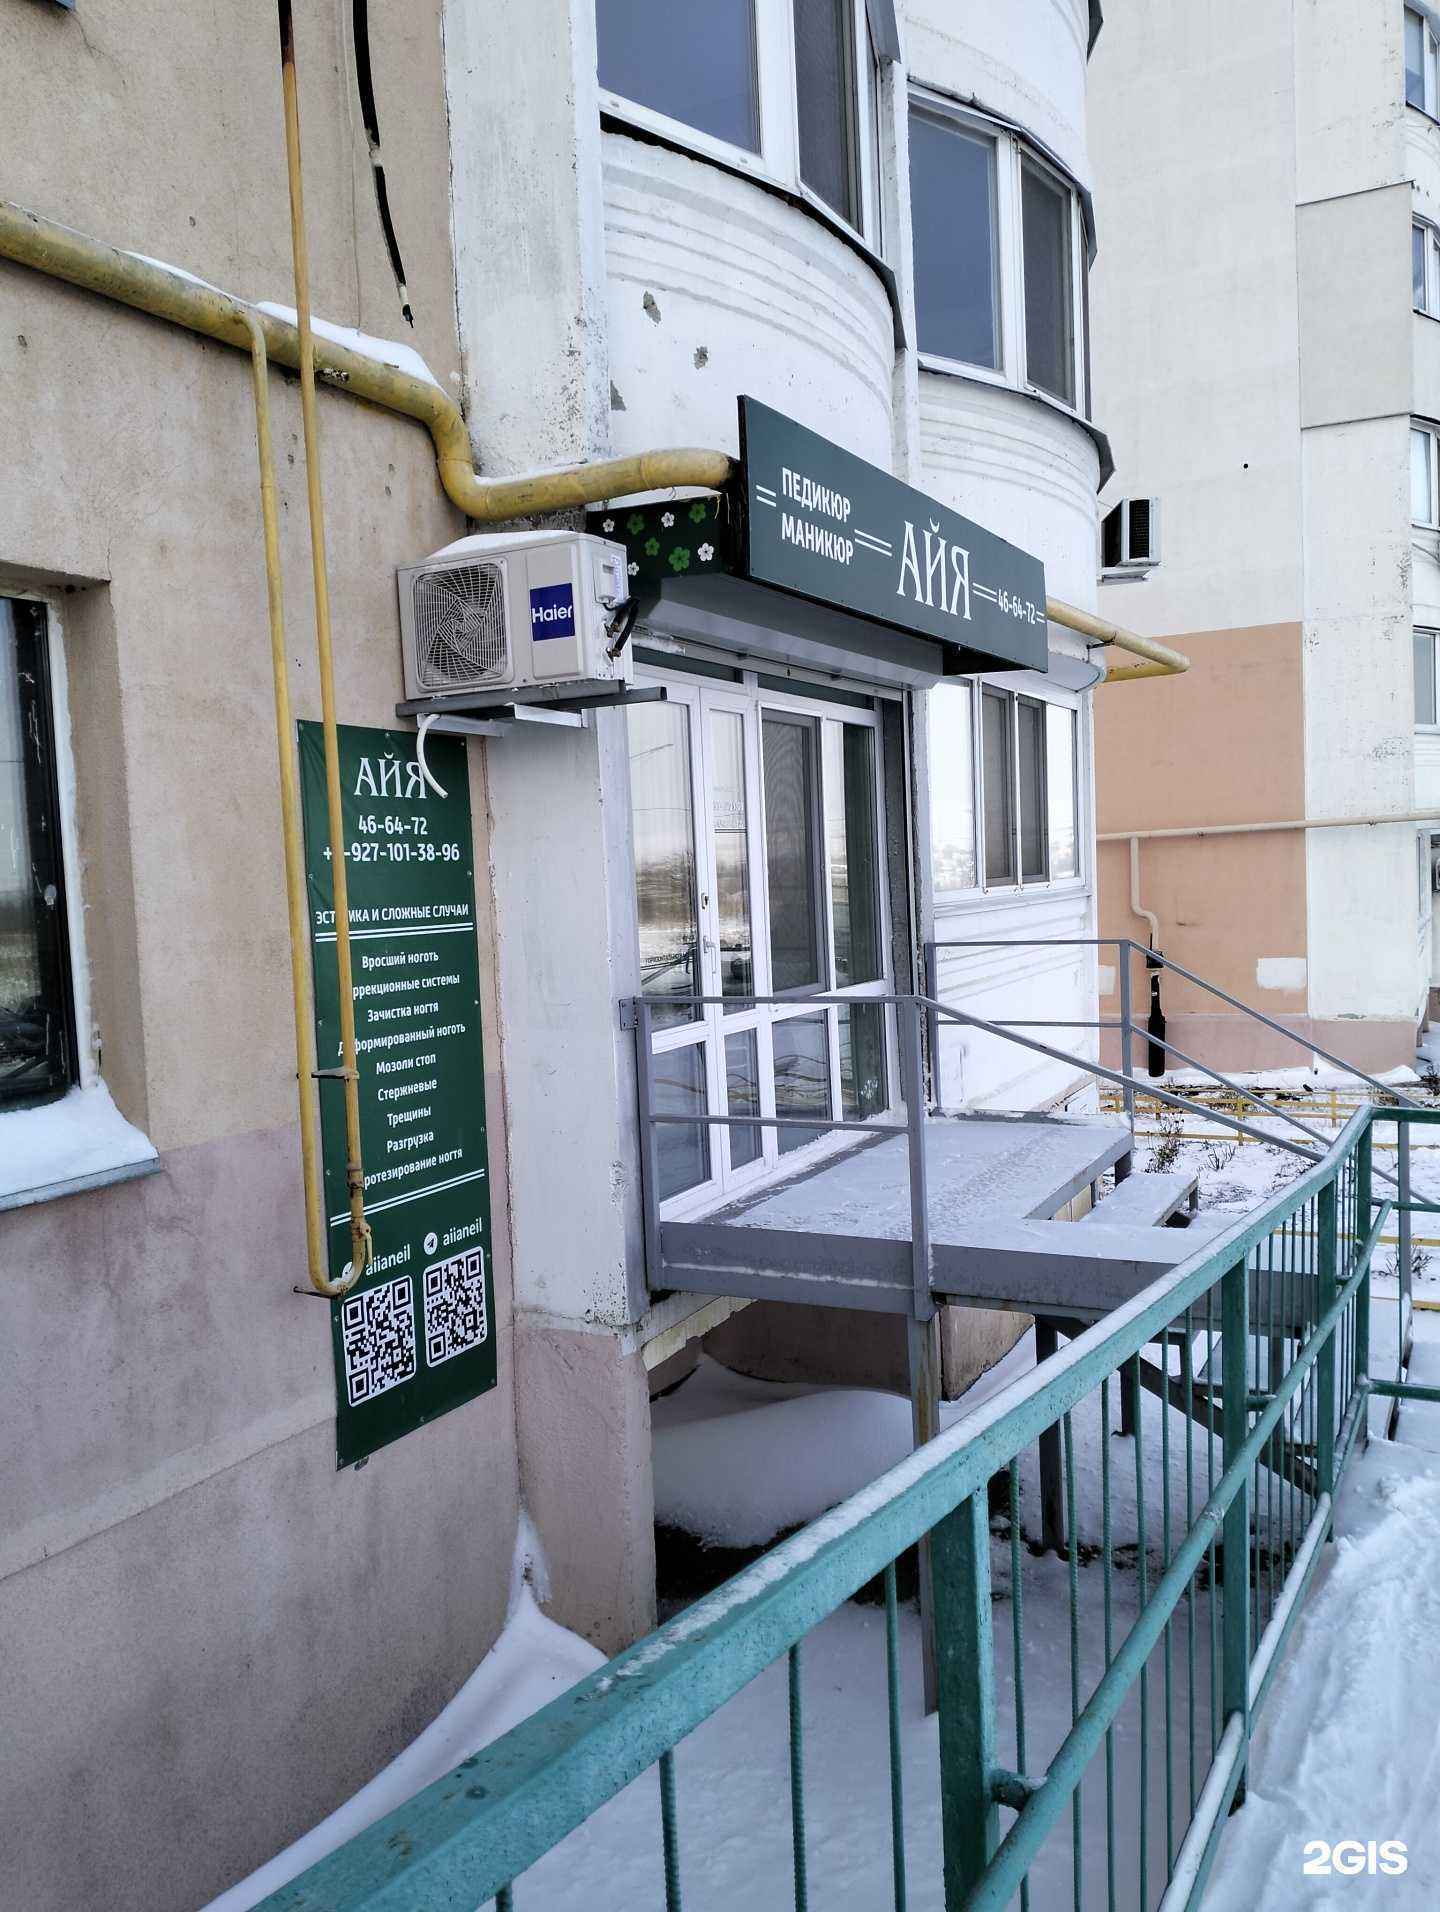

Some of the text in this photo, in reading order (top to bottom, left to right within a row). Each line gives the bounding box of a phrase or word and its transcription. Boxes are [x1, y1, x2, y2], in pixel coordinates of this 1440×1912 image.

[782, 467, 851, 523] ПЕДИКЮР
[781, 512, 854, 566] МАНИКЮР
[896, 516, 972, 621] АЙЯ
[531, 604, 573, 624] Haier
[998, 588, 1037, 626] 46-64-72
[353, 752, 427, 799] АЙЯ
[358, 815, 428, 835] 46-64-72
[323, 842, 460, 862] +-927-101-38-96
[315, 903, 469, 925] ЭСТИКА И СЛОЖНЫЕ СЛУЧАИ
[362, 950, 439, 972] Вросший ноготь
[353, 973, 461, 1000] ррекционные системы
[367, 1001, 439, 1022] Зачистка ногтя
[338, 1023, 466, 1056] Дформированный ноготь
[376, 1053, 436, 1075] Мозоли стоп
[378, 1078, 438, 1101] Стержневые
[387, 1105, 431, 1128] Трещины
[387, 1131, 434, 1153] Разгрузка
[364, 1147, 463, 1190] ротезирование ногтя
